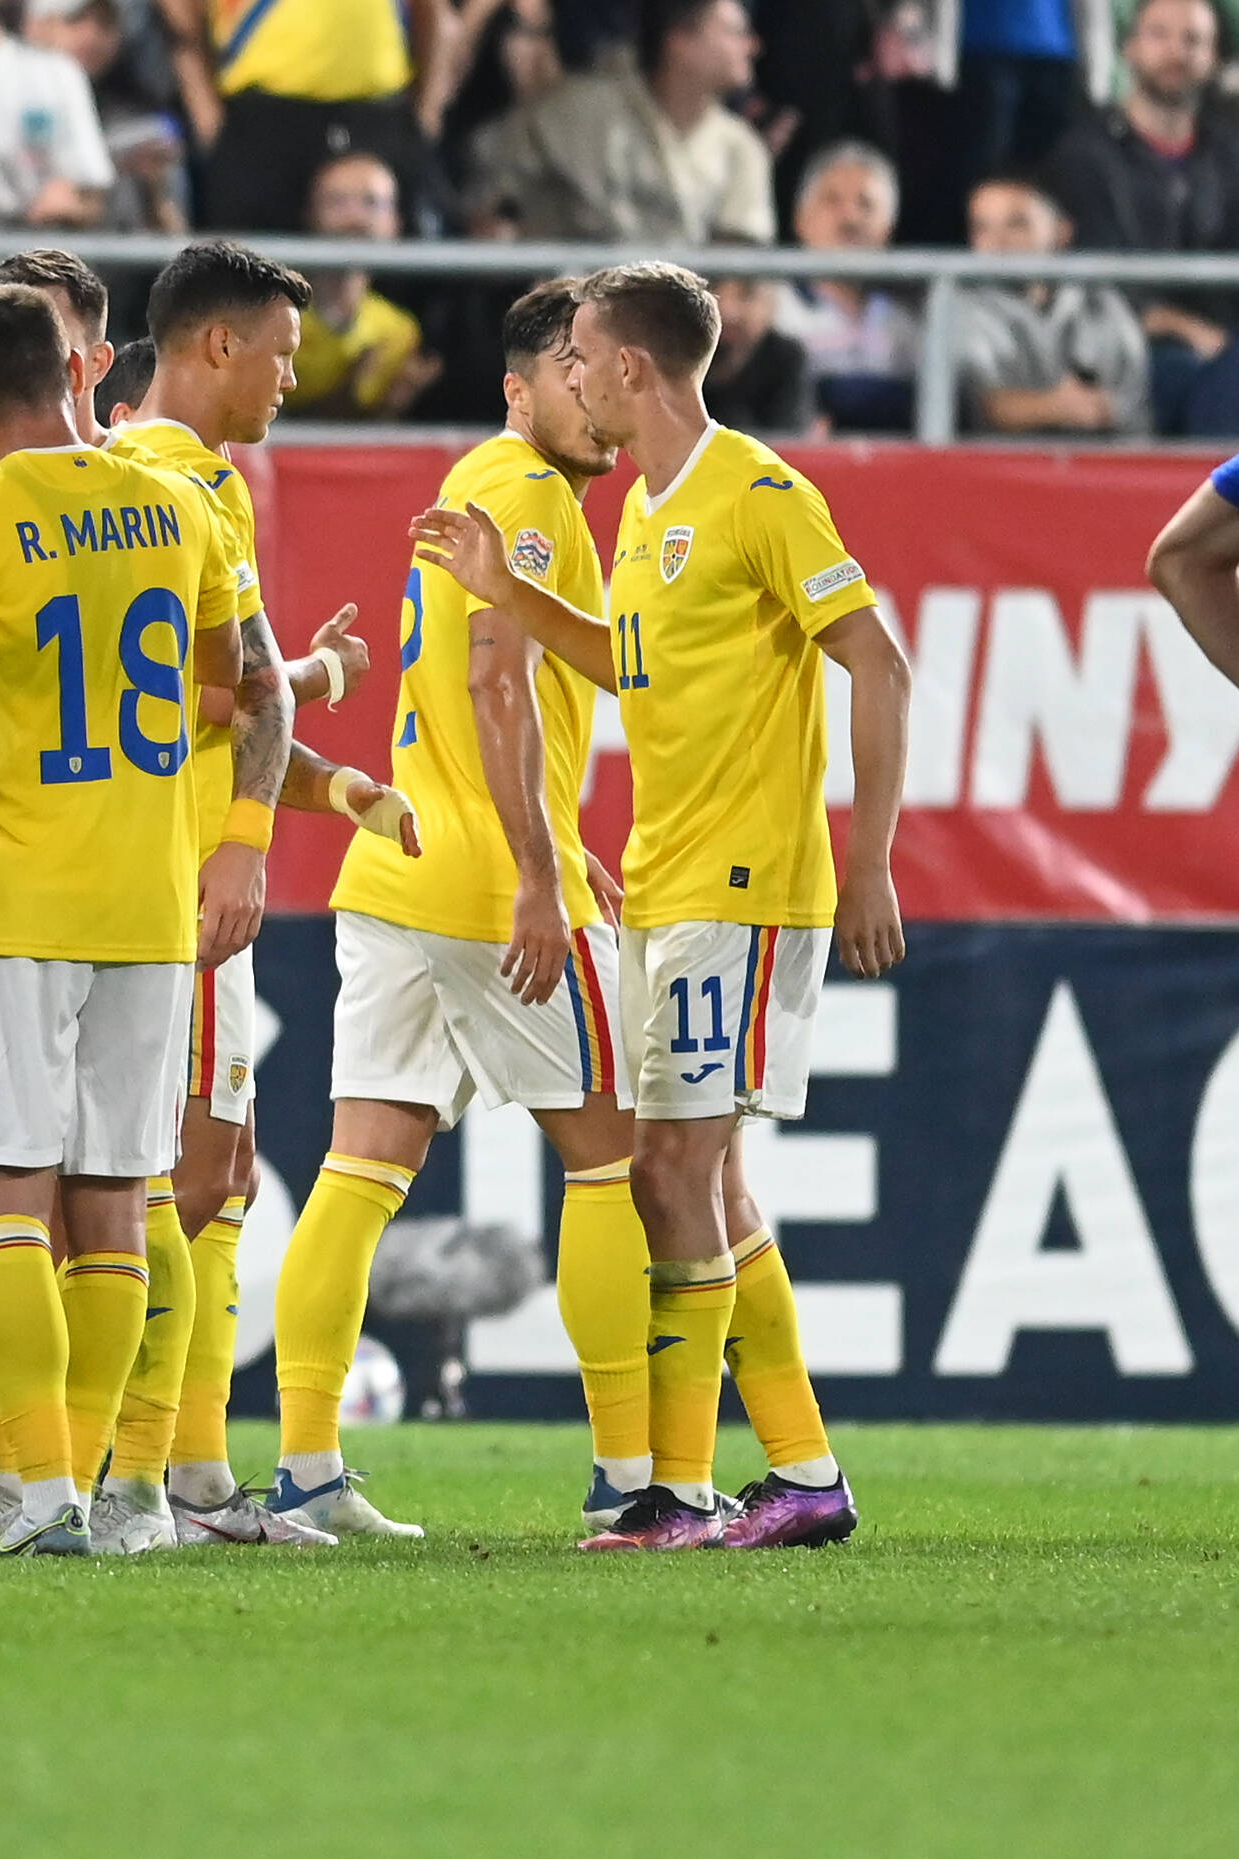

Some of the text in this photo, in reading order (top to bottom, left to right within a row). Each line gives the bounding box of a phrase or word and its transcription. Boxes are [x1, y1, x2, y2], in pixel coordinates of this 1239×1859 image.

[16, 503, 181, 563] R. MARIN
[36, 587, 189, 785] 18
[618, 611, 649, 690] 11
[669, 975, 731, 1053] 11
